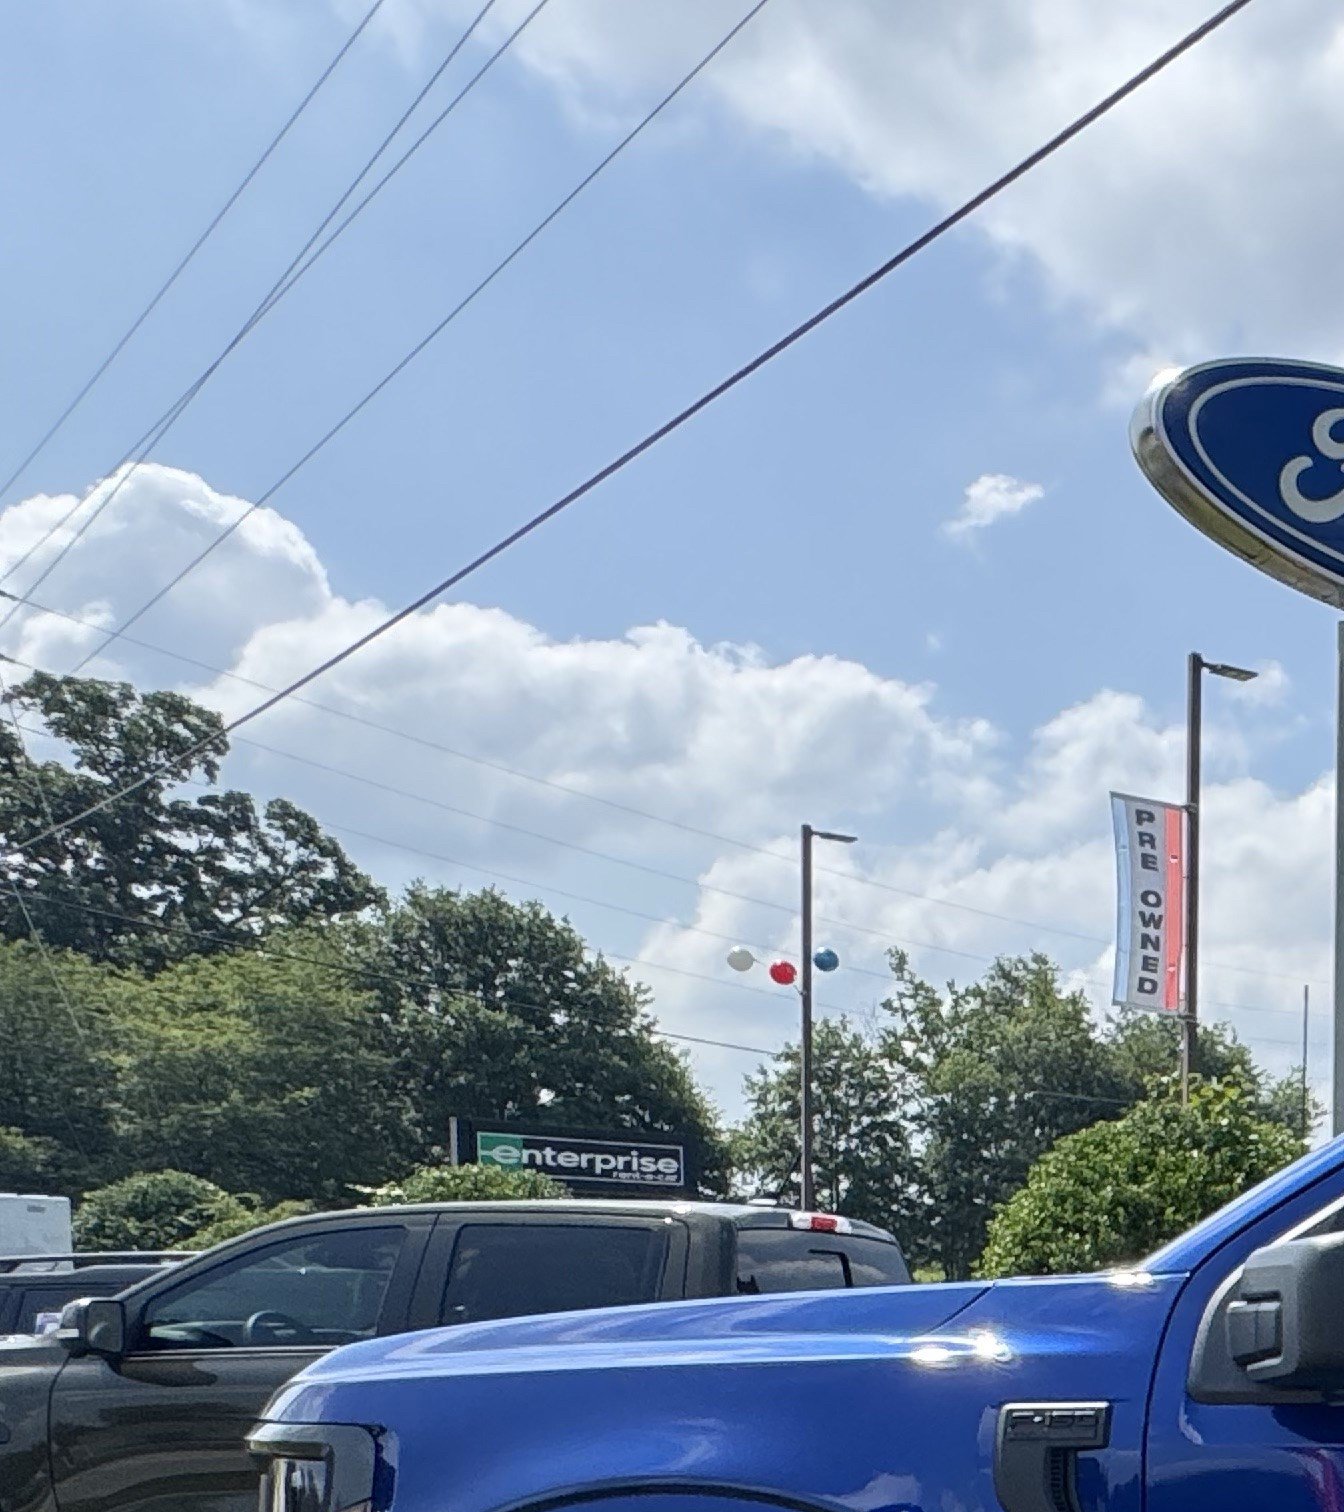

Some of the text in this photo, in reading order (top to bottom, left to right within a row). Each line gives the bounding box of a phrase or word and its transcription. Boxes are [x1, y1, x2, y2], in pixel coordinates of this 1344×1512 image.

[1135, 809, 1164, 995] PRE OWNED
[491, 1144, 679, 1174] enterprise
